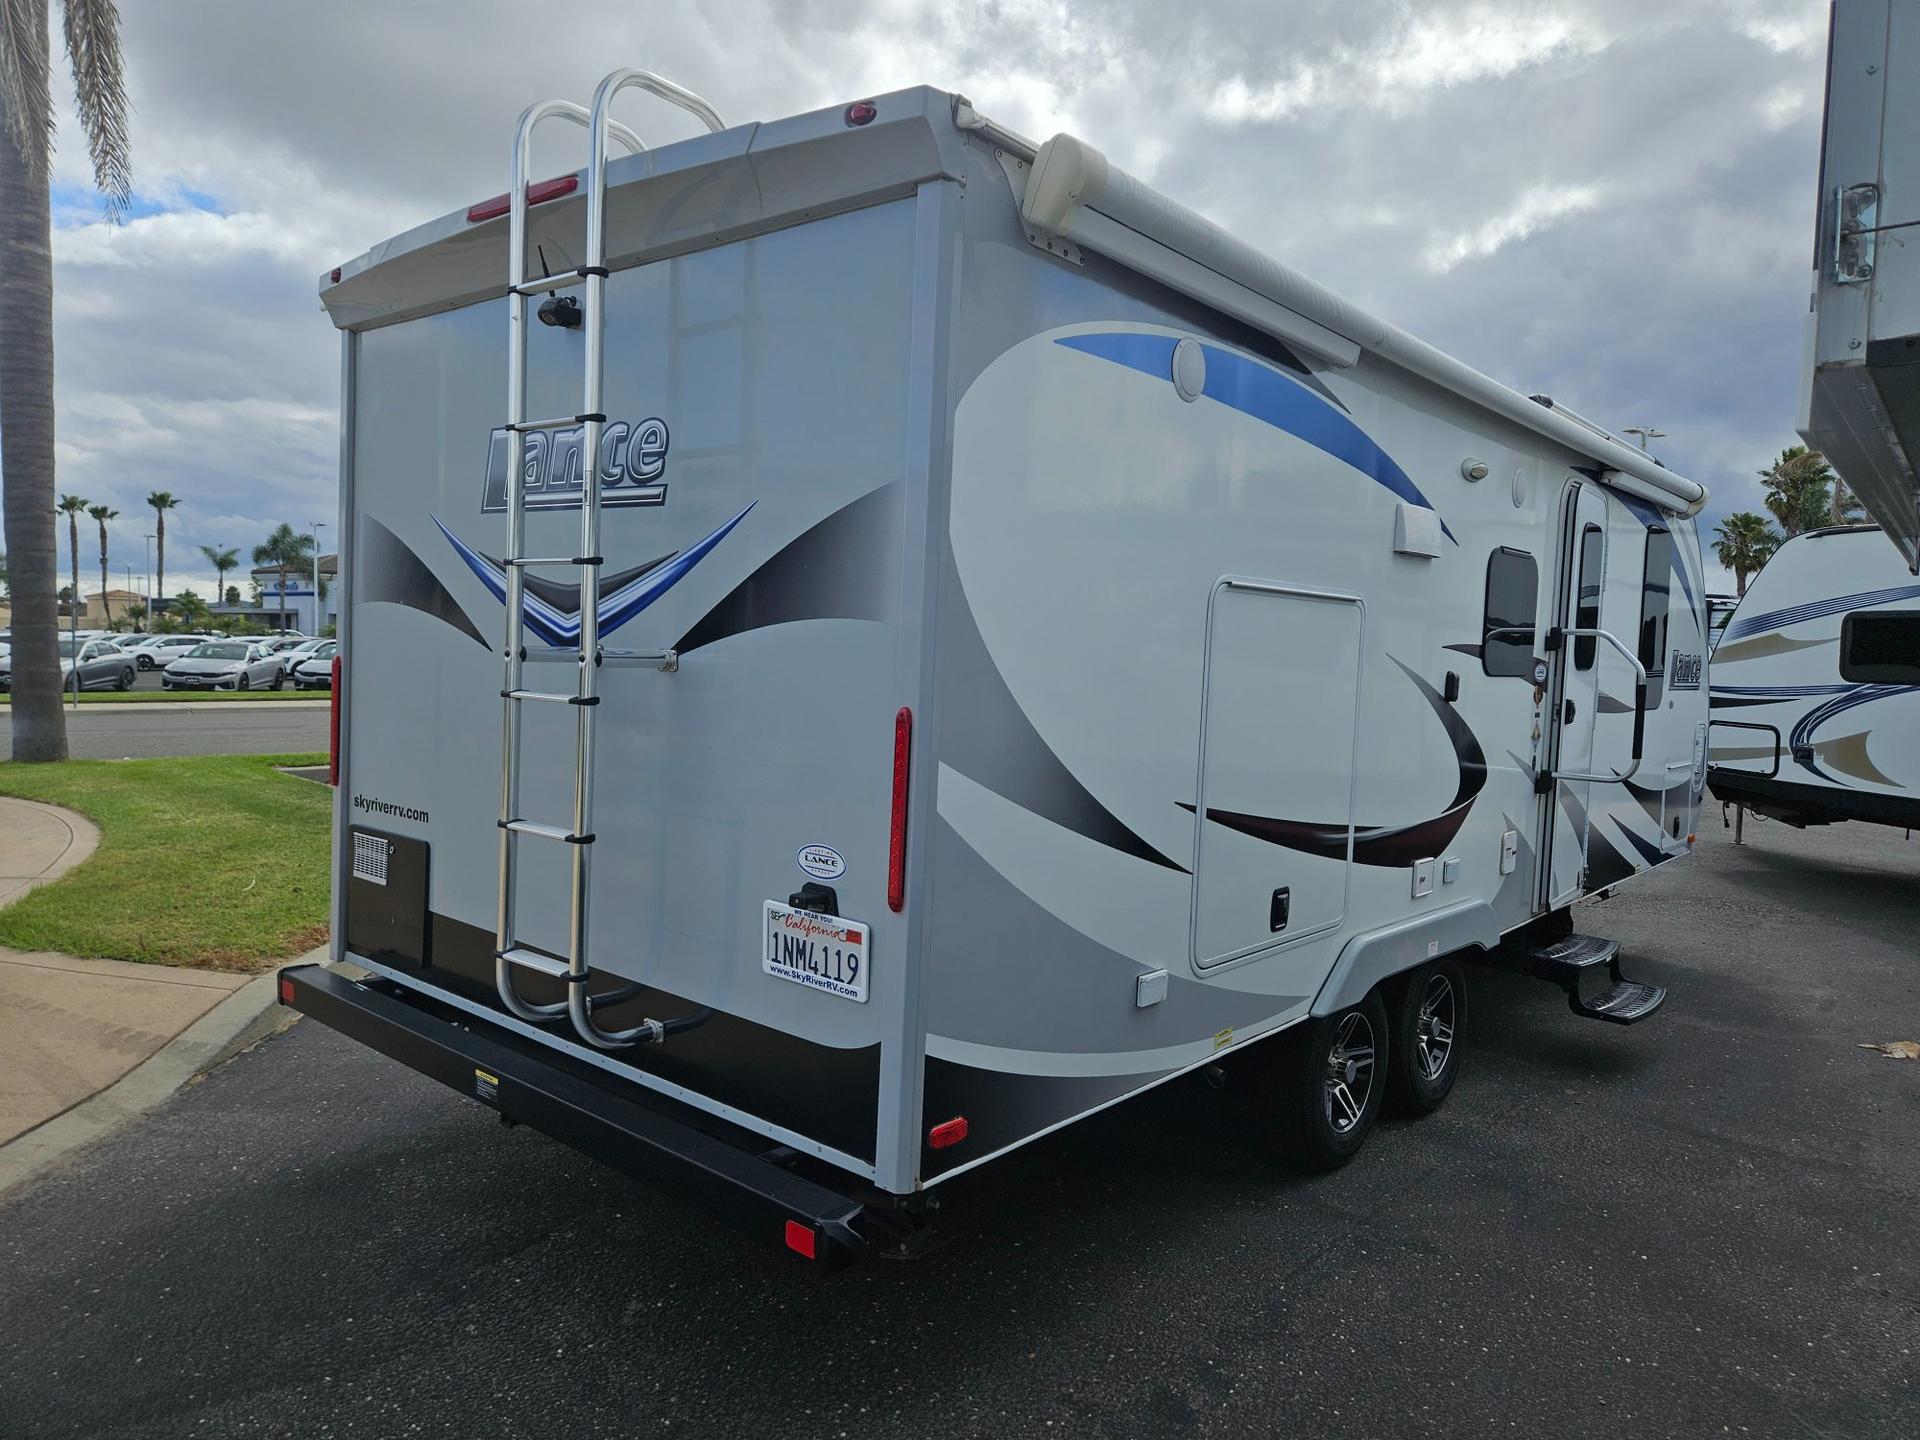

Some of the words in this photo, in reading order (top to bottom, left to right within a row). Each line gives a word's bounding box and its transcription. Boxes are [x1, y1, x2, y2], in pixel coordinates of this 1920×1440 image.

[354, 794, 429, 823] skyriverrv.com
[805, 854, 838, 867] LANCE
[785, 913, 841, 938] California
[803, 911, 819, 920] HEAR
[771, 931, 859, 985] 1NM4119
[770, 965, 858, 997] www.SkyRiverRV.com
